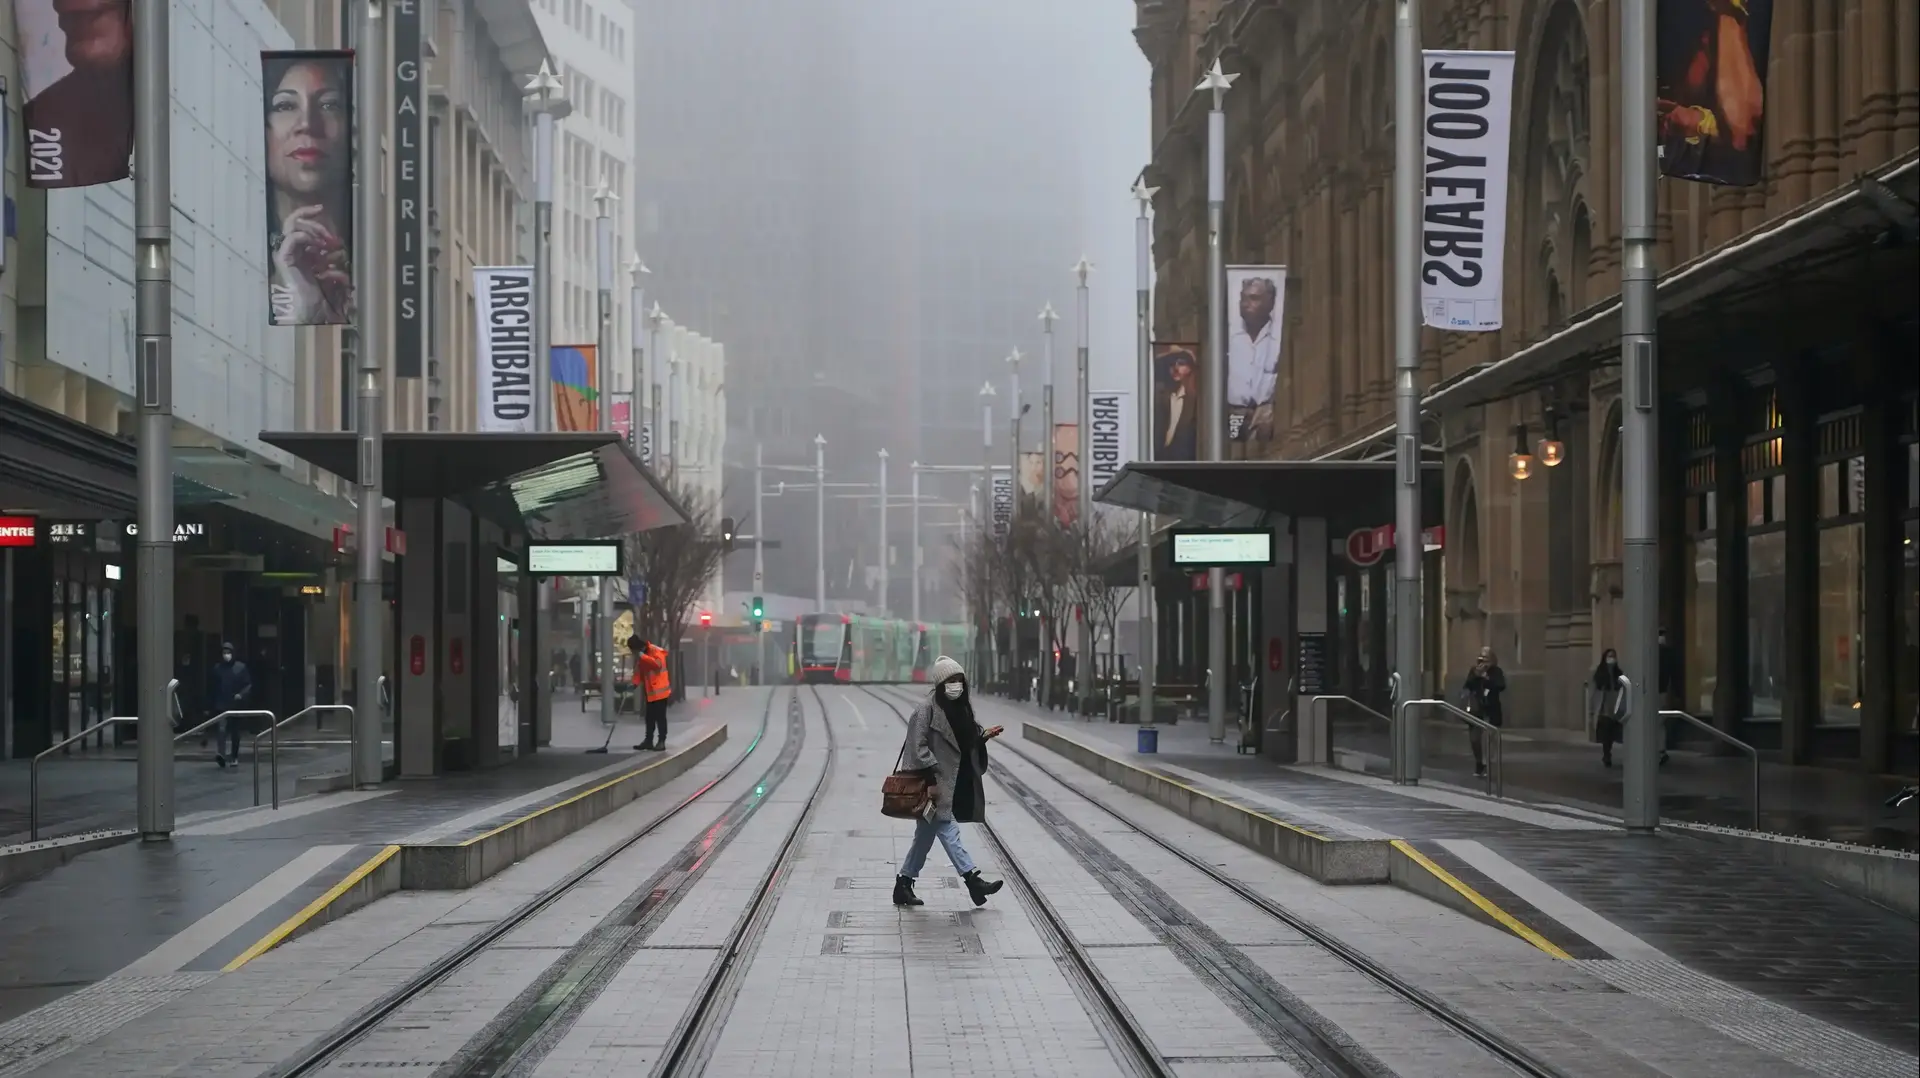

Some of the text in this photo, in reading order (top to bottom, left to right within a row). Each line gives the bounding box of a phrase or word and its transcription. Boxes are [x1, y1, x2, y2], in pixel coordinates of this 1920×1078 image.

[29, 128, 62, 181] 2021
[397, 61, 418, 320] GALERIES
[271, 283, 295, 322] 2021
[490, 275, 530, 420] ARCHIBALD
[0, 527, 35, 536] NTRE
[126, 523, 204, 536] GANI
